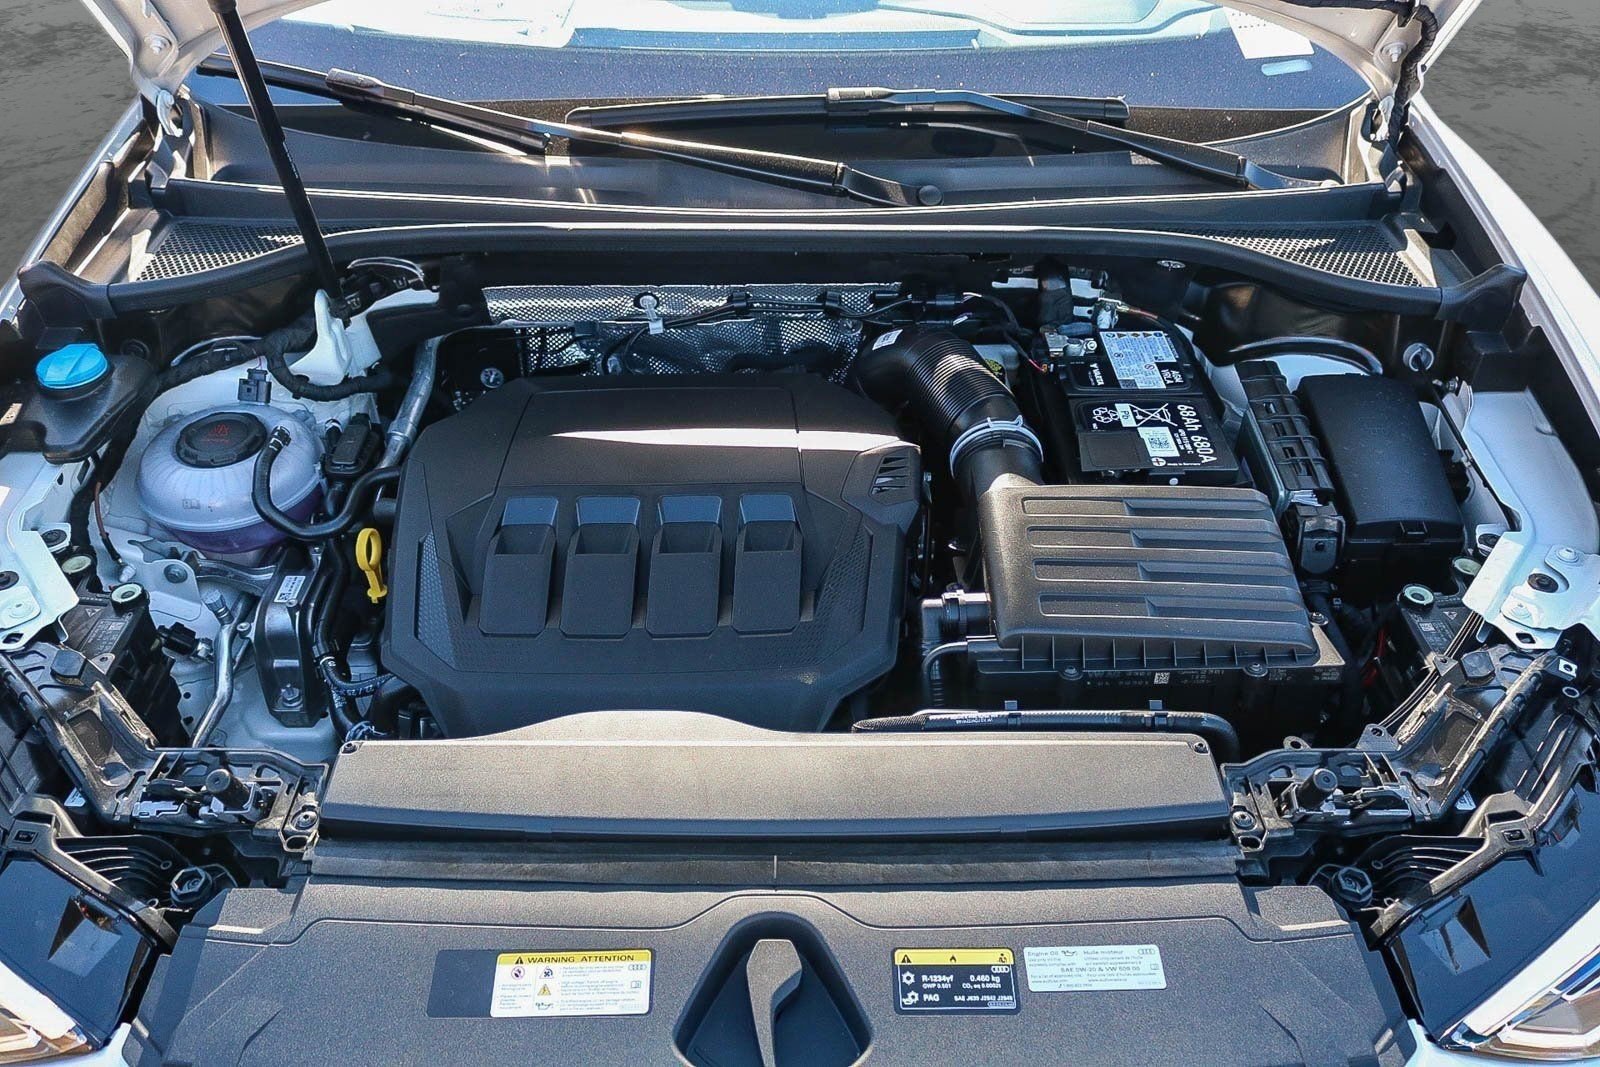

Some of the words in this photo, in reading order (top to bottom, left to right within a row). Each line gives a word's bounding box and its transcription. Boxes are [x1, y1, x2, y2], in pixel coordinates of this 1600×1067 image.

[1120, 410, 1130, 420] Pb
[1177, 404, 1202, 431] 68Ah
[1190, 436, 1218, 464] 680A
[580, 954, 634, 962] ATTENTION
[922, 974, 954, 983] R-1234yf
[991, 974, 1000, 984] kg
[922, 994, 940, 1002] PAG
